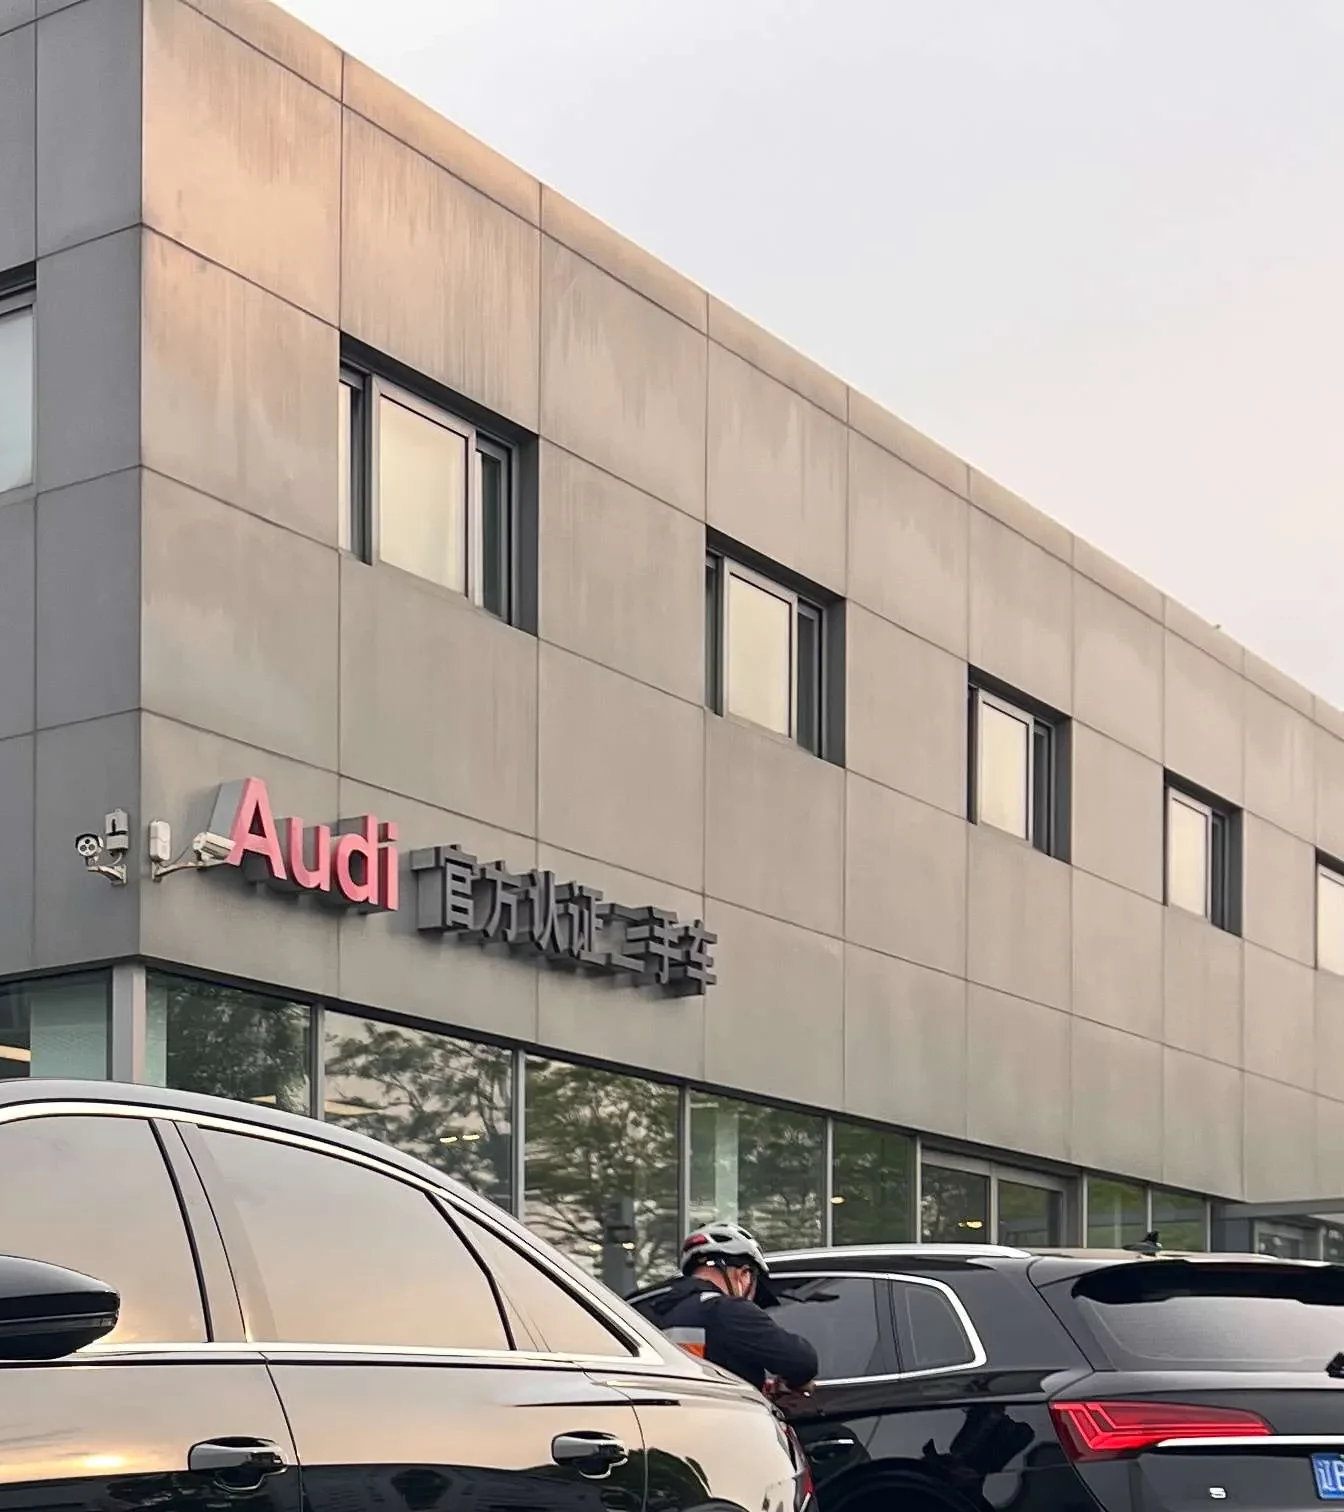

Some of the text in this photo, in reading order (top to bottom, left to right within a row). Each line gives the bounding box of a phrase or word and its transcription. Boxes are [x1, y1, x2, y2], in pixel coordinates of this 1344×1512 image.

[216, 776, 718, 995] Audi 官方认证二手车
